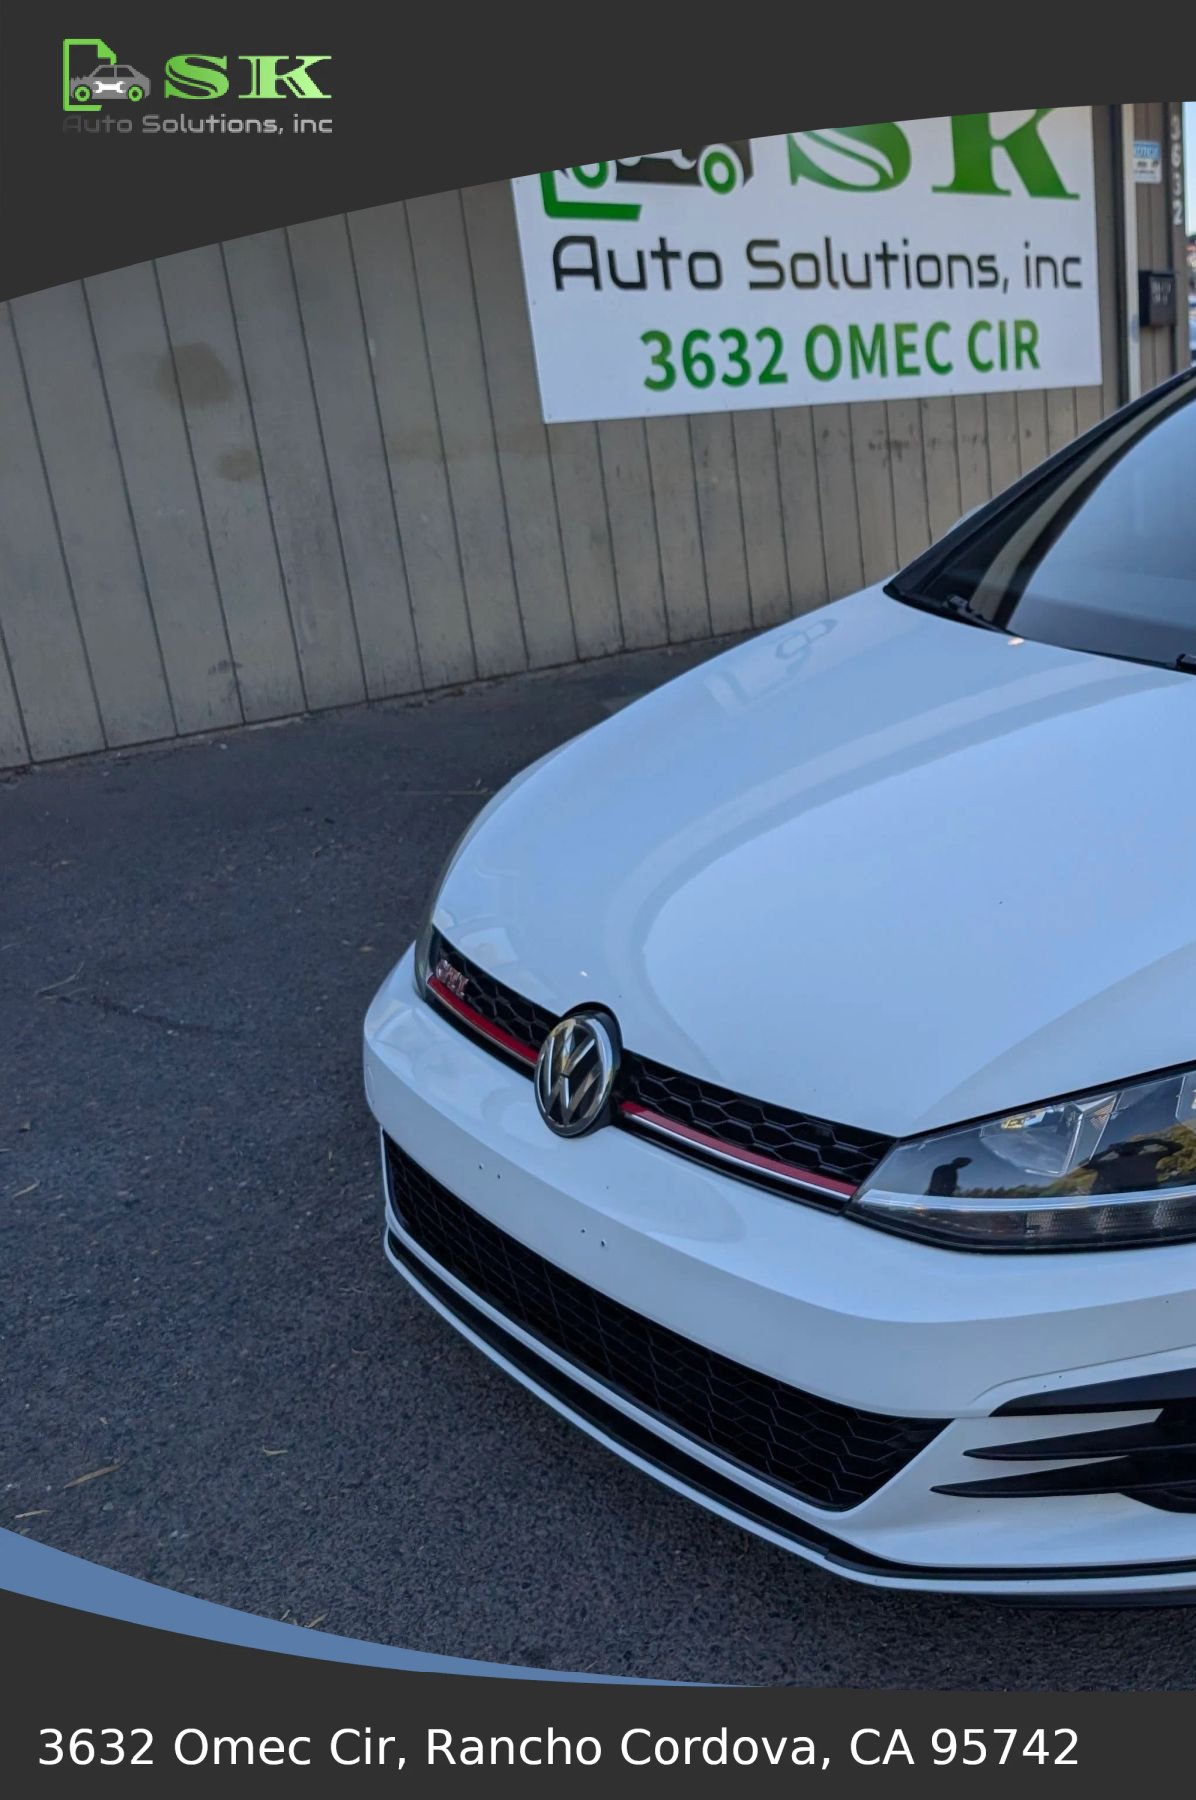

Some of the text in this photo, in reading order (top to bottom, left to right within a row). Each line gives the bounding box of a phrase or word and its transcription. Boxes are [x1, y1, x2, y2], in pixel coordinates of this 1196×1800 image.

[552, 235, 1082, 295] Auto Solutions, inc
[639, 318, 1040, 391] 3632 OMEC CIR
